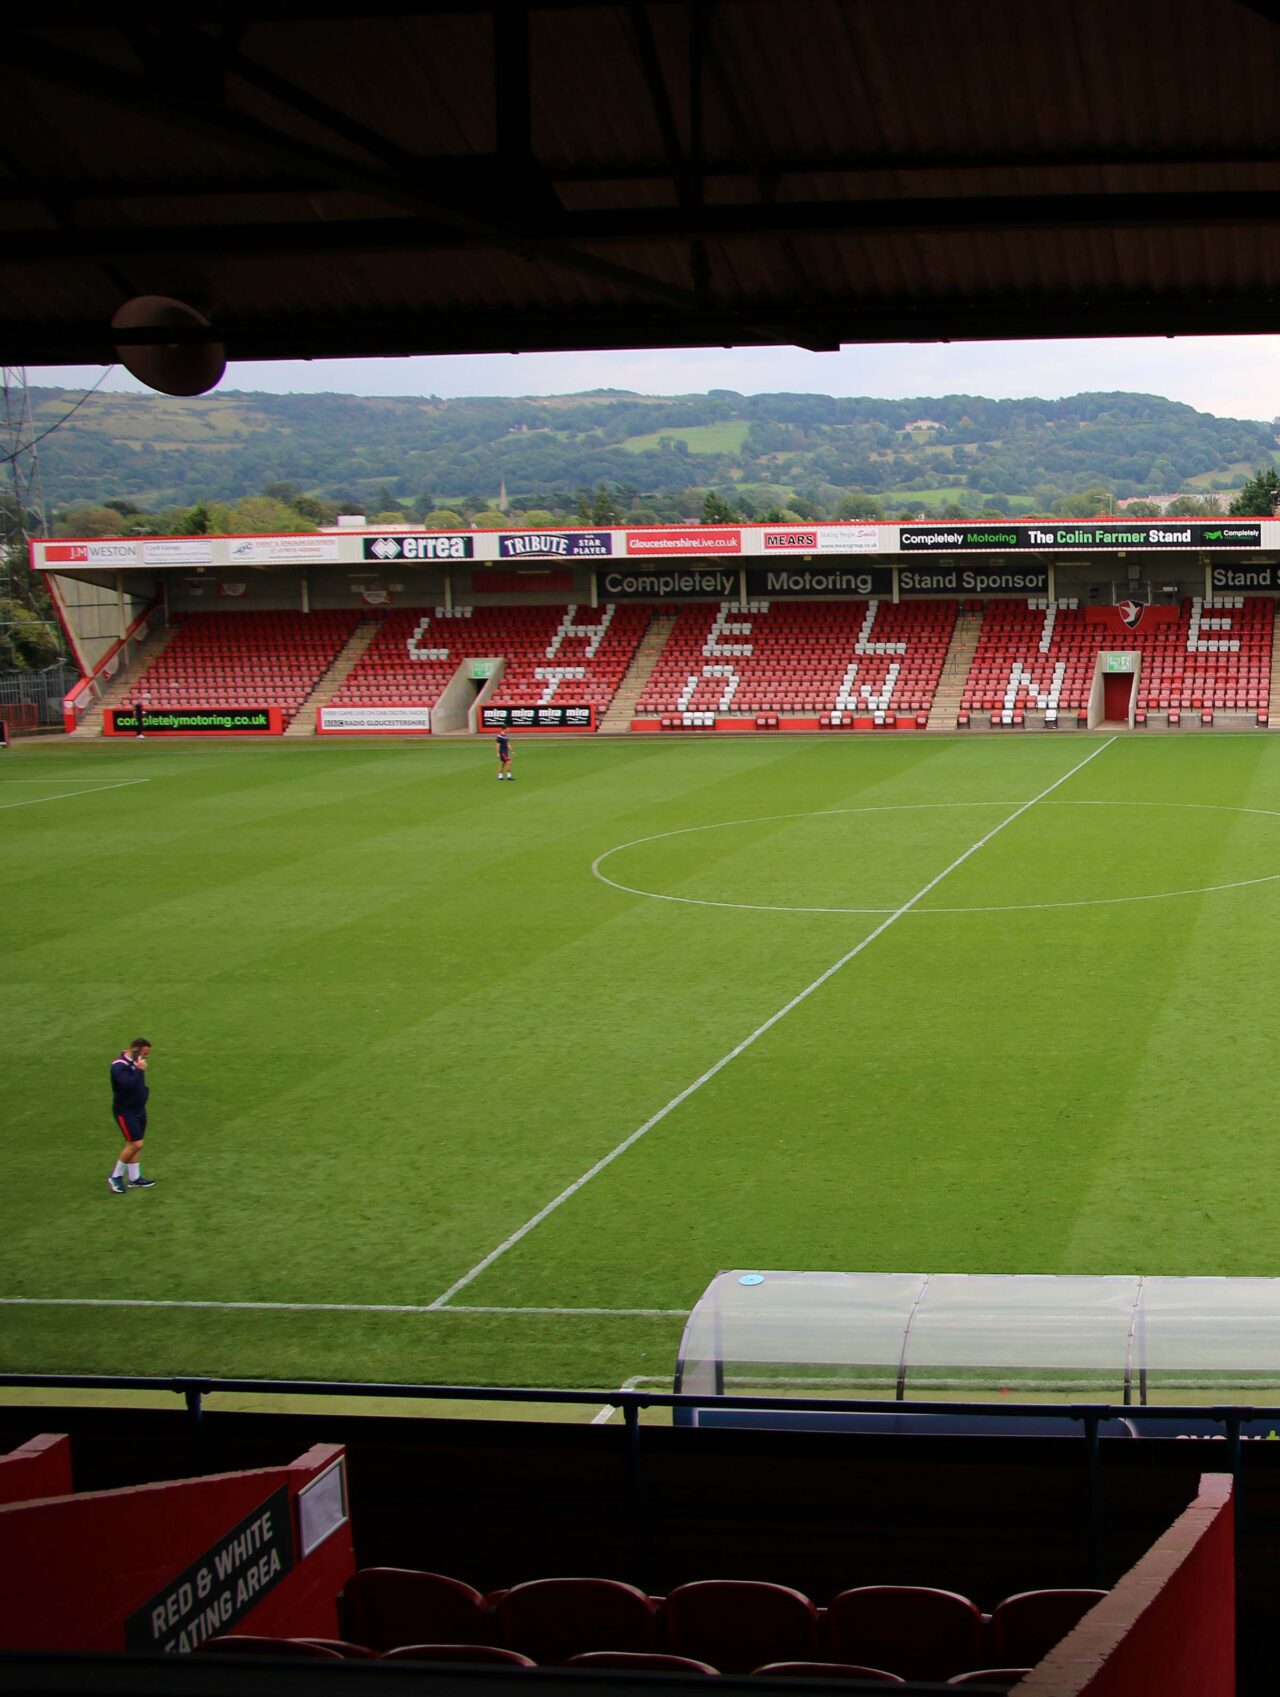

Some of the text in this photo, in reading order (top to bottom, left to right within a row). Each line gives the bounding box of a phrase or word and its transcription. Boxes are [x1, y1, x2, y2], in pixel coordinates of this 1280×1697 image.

[901, 533, 1017, 545] Completely Motoring
[1028, 529, 1191, 544] The Colin Farmer Stand
[1223, 529, 1259, 537] Completely
[504, 535, 569, 555] TRIBUTE
[629, 538, 738, 549] GloucestershireLive.co.uk
[767, 535, 814, 547] MEARS
[90, 546, 136, 557] WESTON
[402, 537, 465, 558] errea
[573, 547, 607, 555] PLAYER
[605, 571, 1046, 595] Completely Motoring Stand Sponsor
[1213, 569, 1271, 586] Stand
[484, 709, 507, 717] mira
[511, 708, 535, 717] mira
[538, 708, 562, 717] mira
[565, 708, 589, 716] mira
[152, 1511, 273, 1639] RED & WHITE
[236, 1548, 282, 1610] AREA
